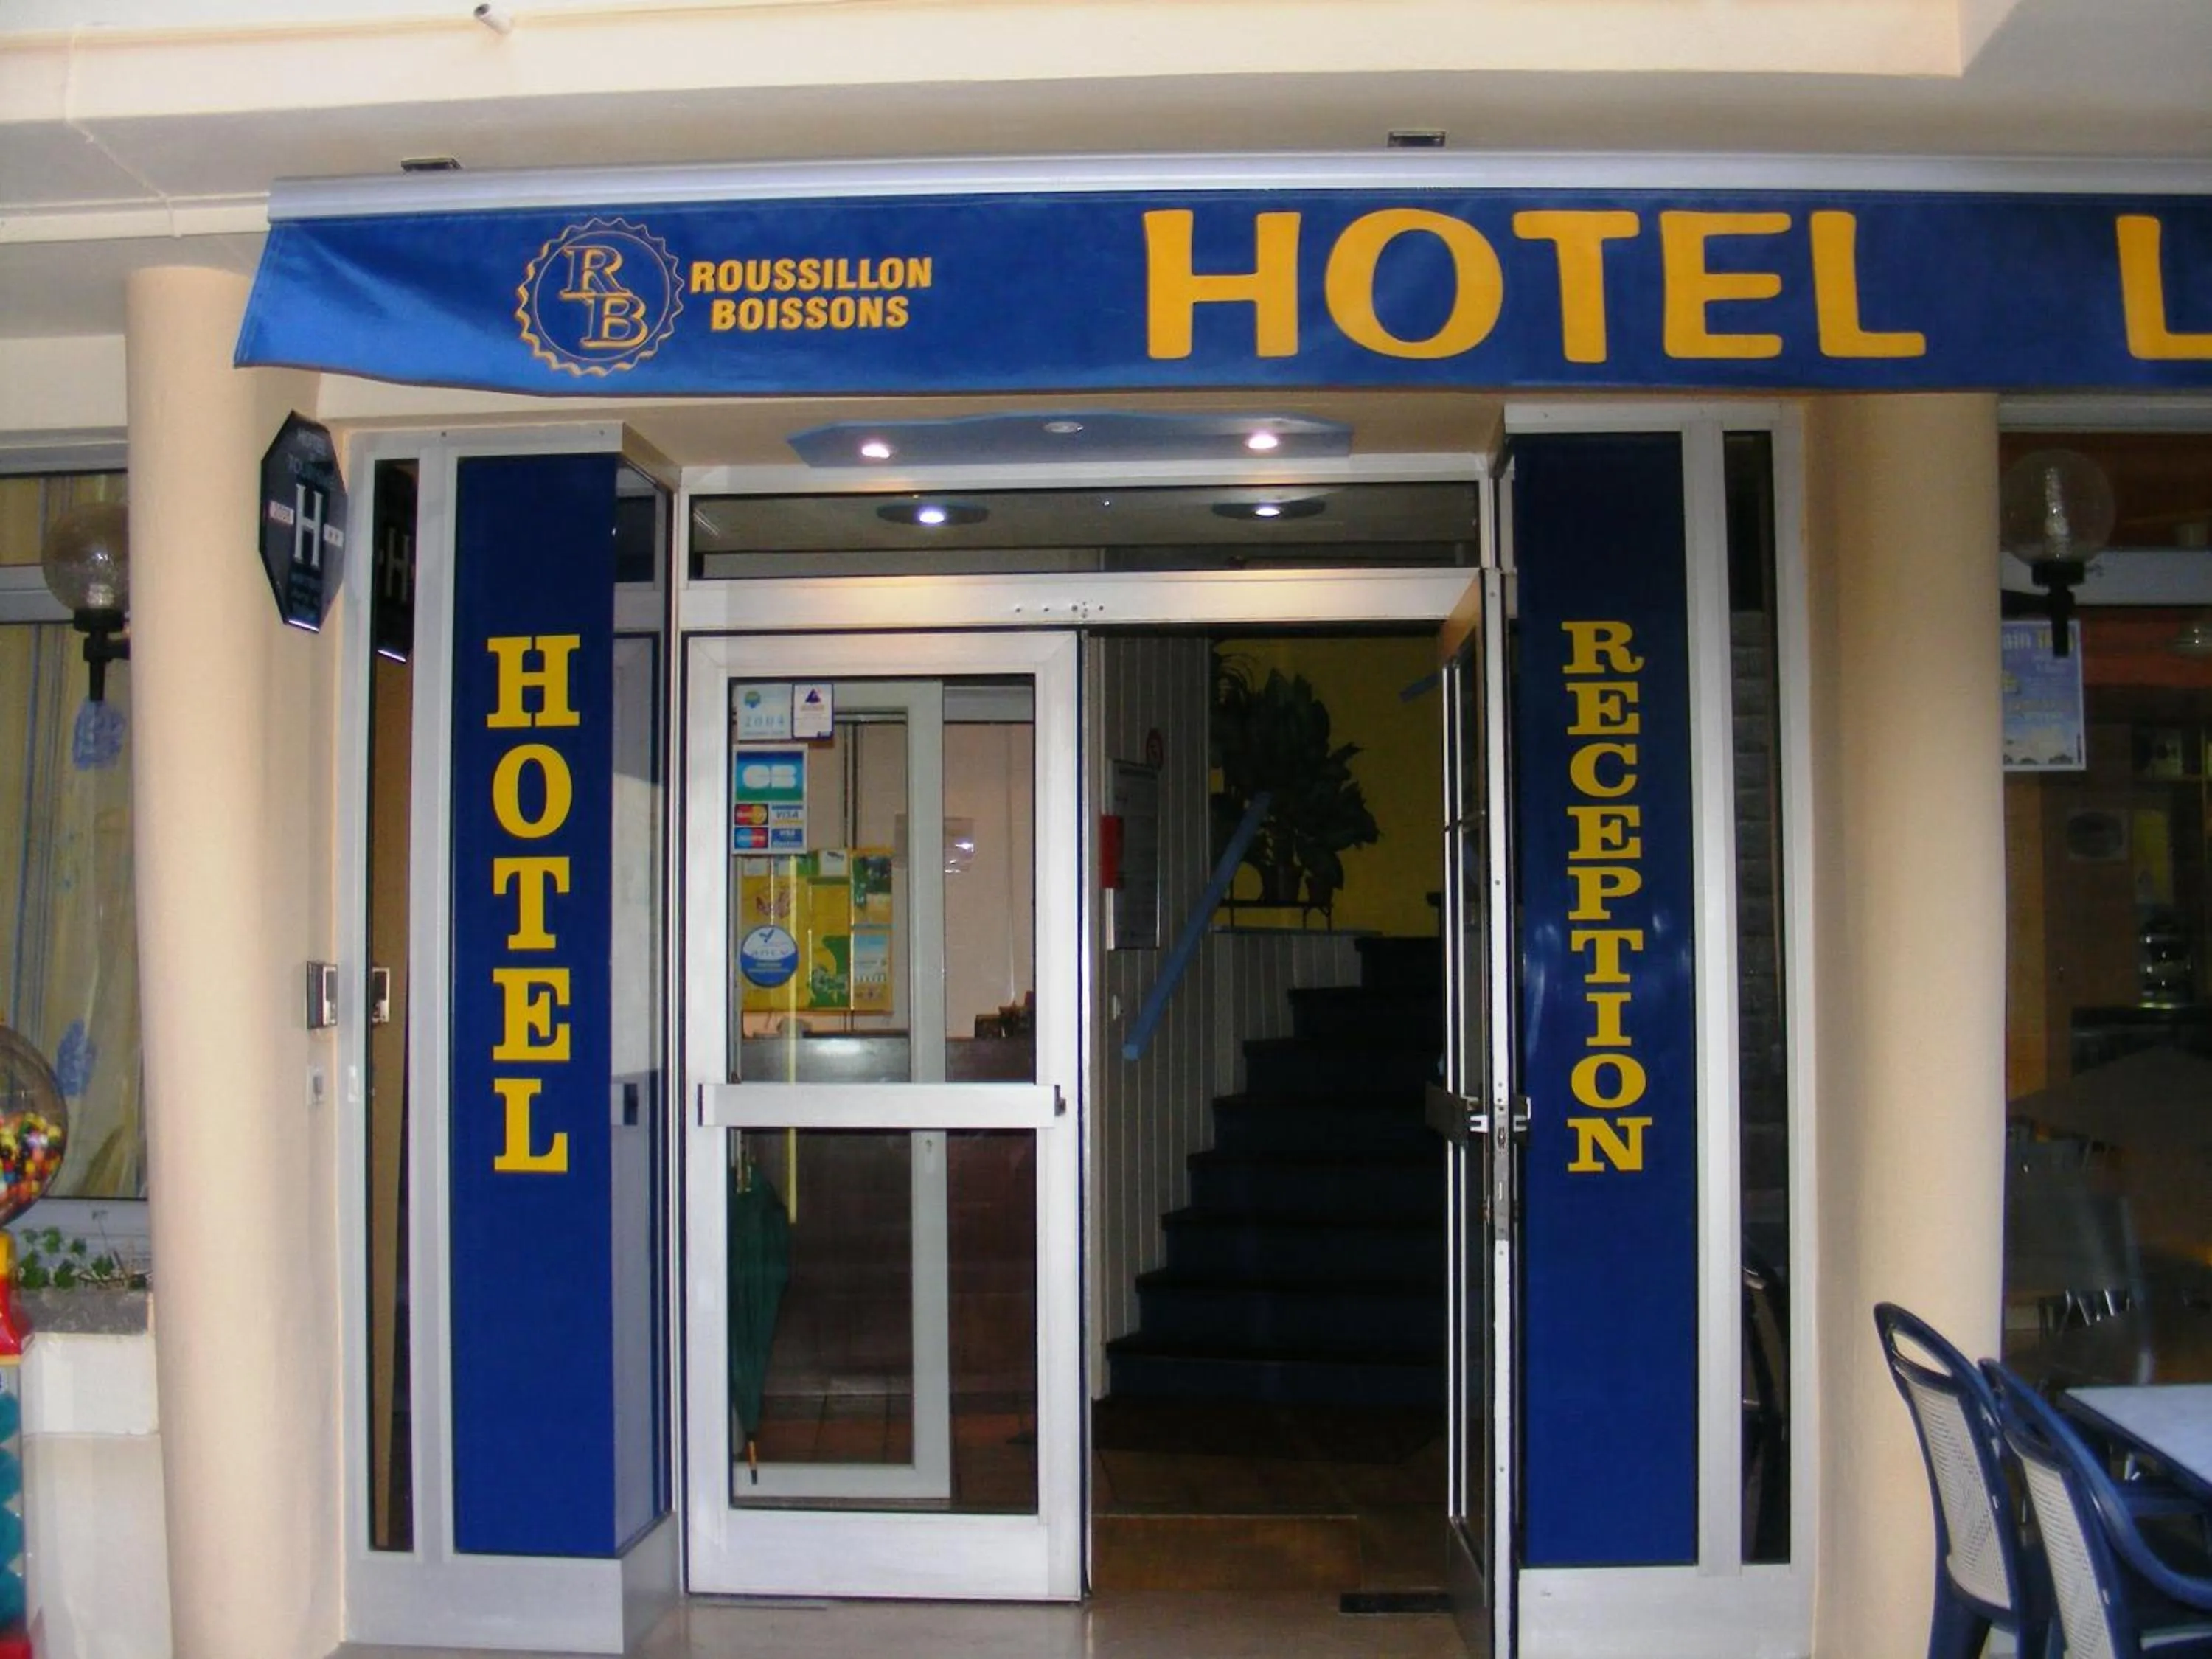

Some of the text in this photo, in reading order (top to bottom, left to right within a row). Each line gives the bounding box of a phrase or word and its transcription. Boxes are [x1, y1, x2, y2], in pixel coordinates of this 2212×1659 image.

[689, 257, 933, 293] ROUSSILLON
[1144, 208, 1926, 363] HOTEL
[710, 295, 909, 332] BOISSONS
[293, 483, 323, 573] H
[742, 764, 796, 789] CB
[776, 810, 799, 818] VISA
[486, 633, 581, 1172] HOTEL
[1561, 620, 1652, 1172] RECEPTION
